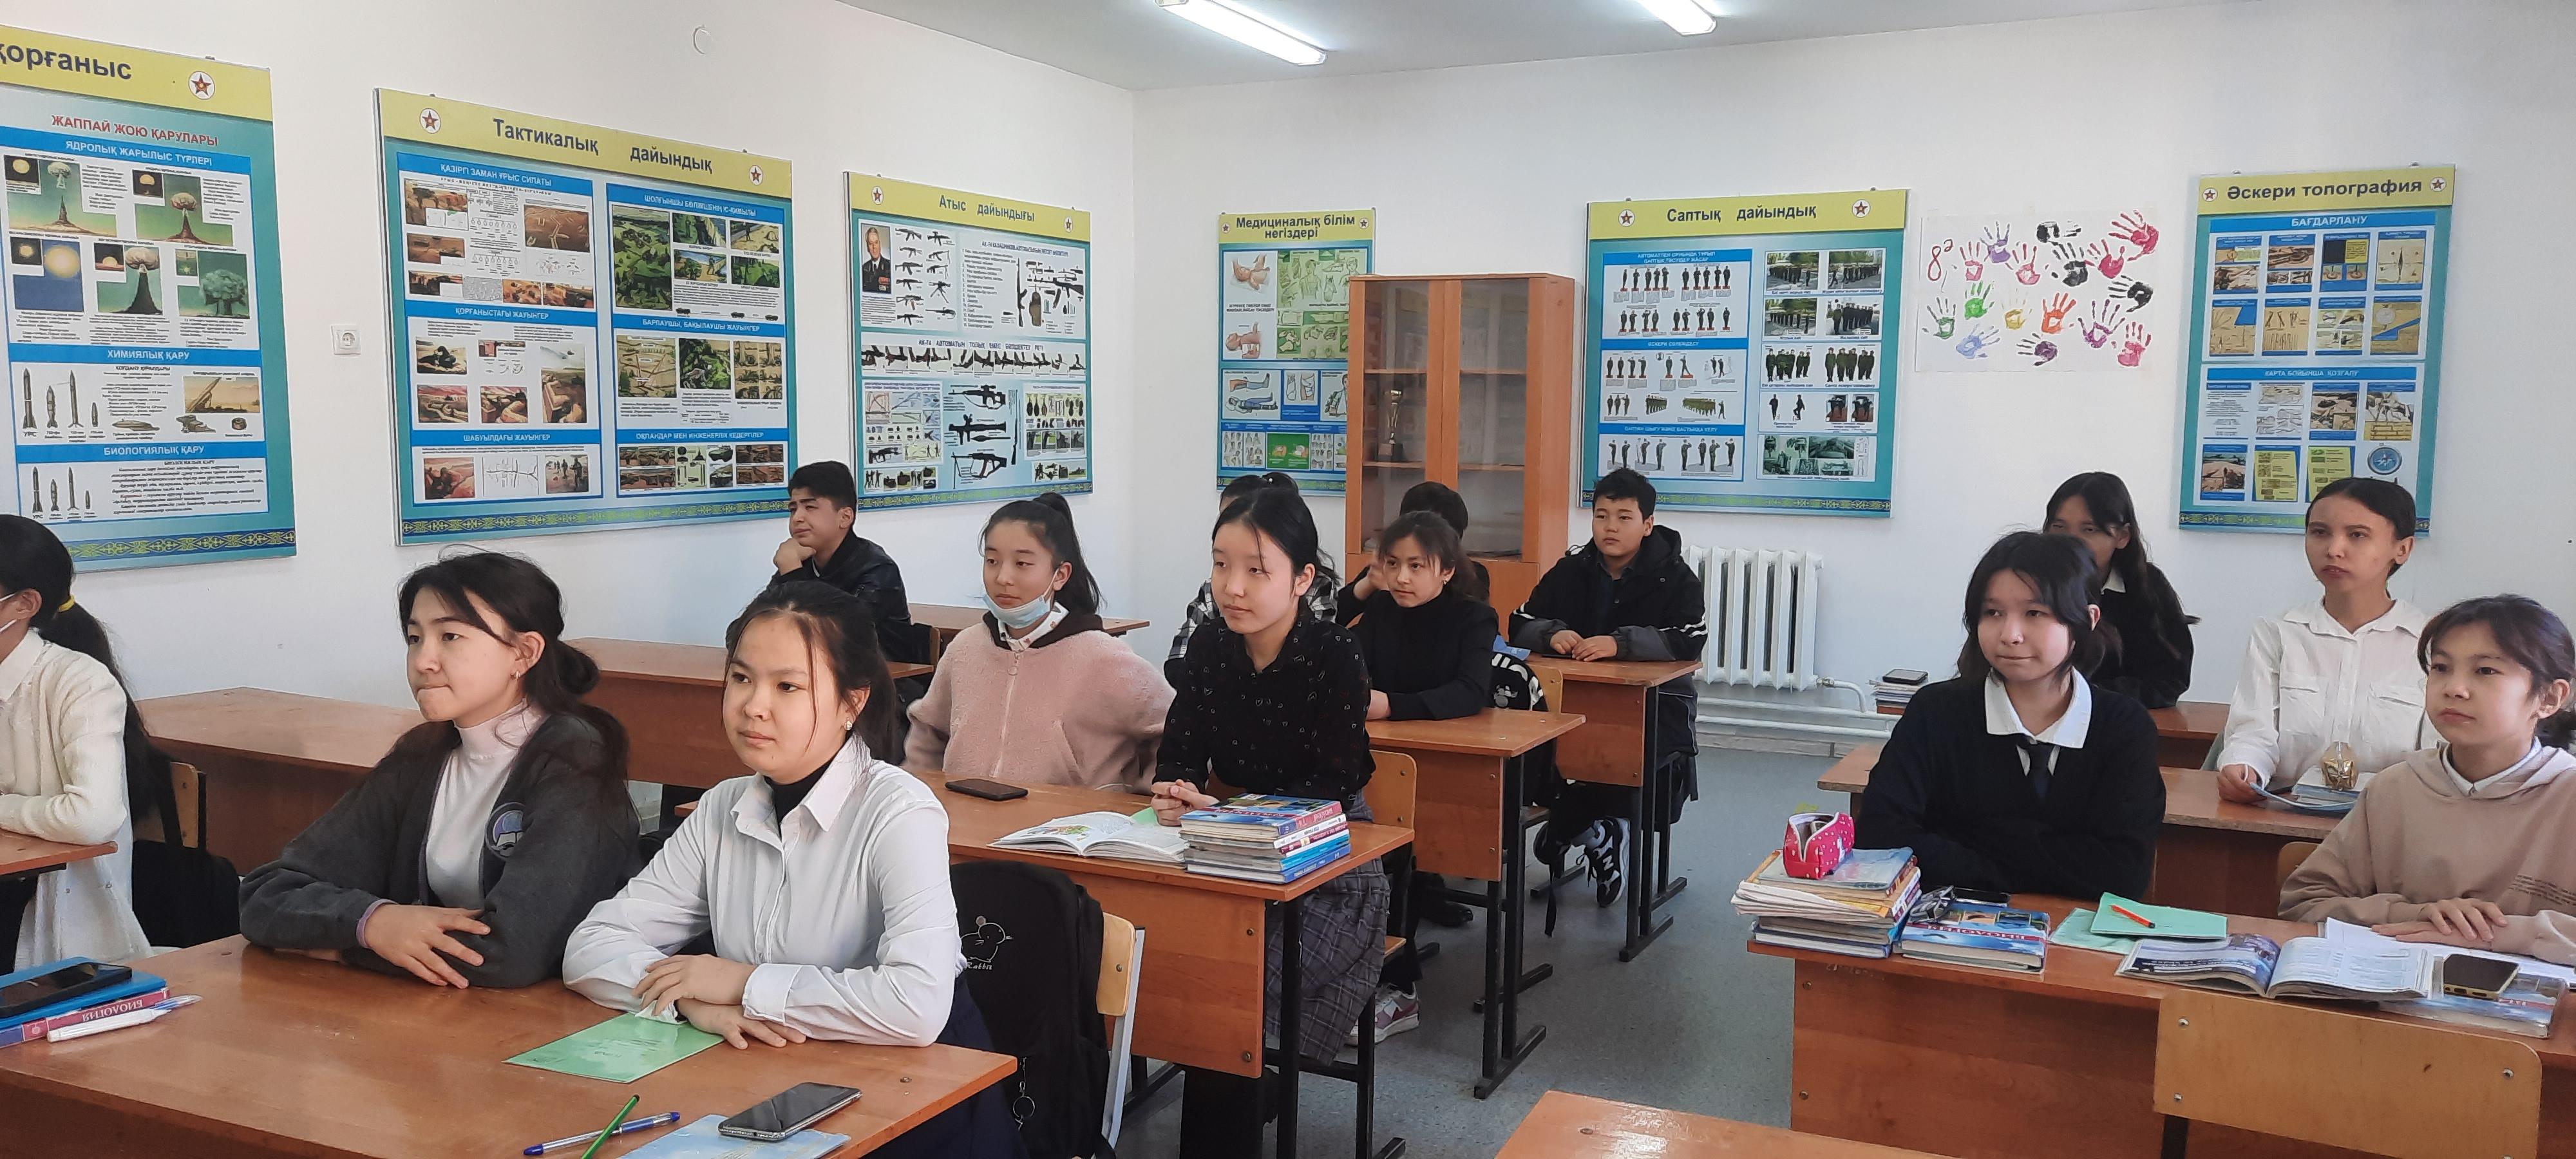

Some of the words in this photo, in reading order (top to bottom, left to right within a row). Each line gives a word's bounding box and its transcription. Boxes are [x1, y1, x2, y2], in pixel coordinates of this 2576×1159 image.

[52, 115, 111, 133] ЖАППАЙ
[114, 123, 147, 137] ЖОЮ
[151, 128, 218, 146] ҚАРУЛАРЫ
[66, 140, 117, 156] ЯДРОЛЫҚ
[119, 147, 173, 162] ЖАРЫЛЫС
[175, 154, 212, 165] ТҮРЛЕРІ
[493, 118, 599, 156] Тактикалық
[630, 146, 712, 174] дайындық
[471, 168, 497, 179] ЗАМАН
[521, 174, 552, 187] СИПАТЫ
[2228, 185, 2295, 201] Әскери
[2302, 180, 2422, 197] топография
[939, 194, 966, 211] Атыс
[977, 202, 1035, 222] дайындығы
[1667, 208, 1721, 223] Саптық
[1737, 204, 1817, 221] дайындық
[1236, 217, 1320, 229] Медициналық
[1324, 214, 1355, 225] білім
[2291, 216, 2368, 227] БАҒДАРЛАНУ
[1265, 227, 1318, 240] негіздері
[108, 349, 164, 360] ХИМИЯЛЫҚ
[166, 352, 189, 361] ҚАРУ
[104, 446, 179, 456] БИОЛОГИЯЛЫҚ
[181, 446, 204, 455] ҚАРУ
